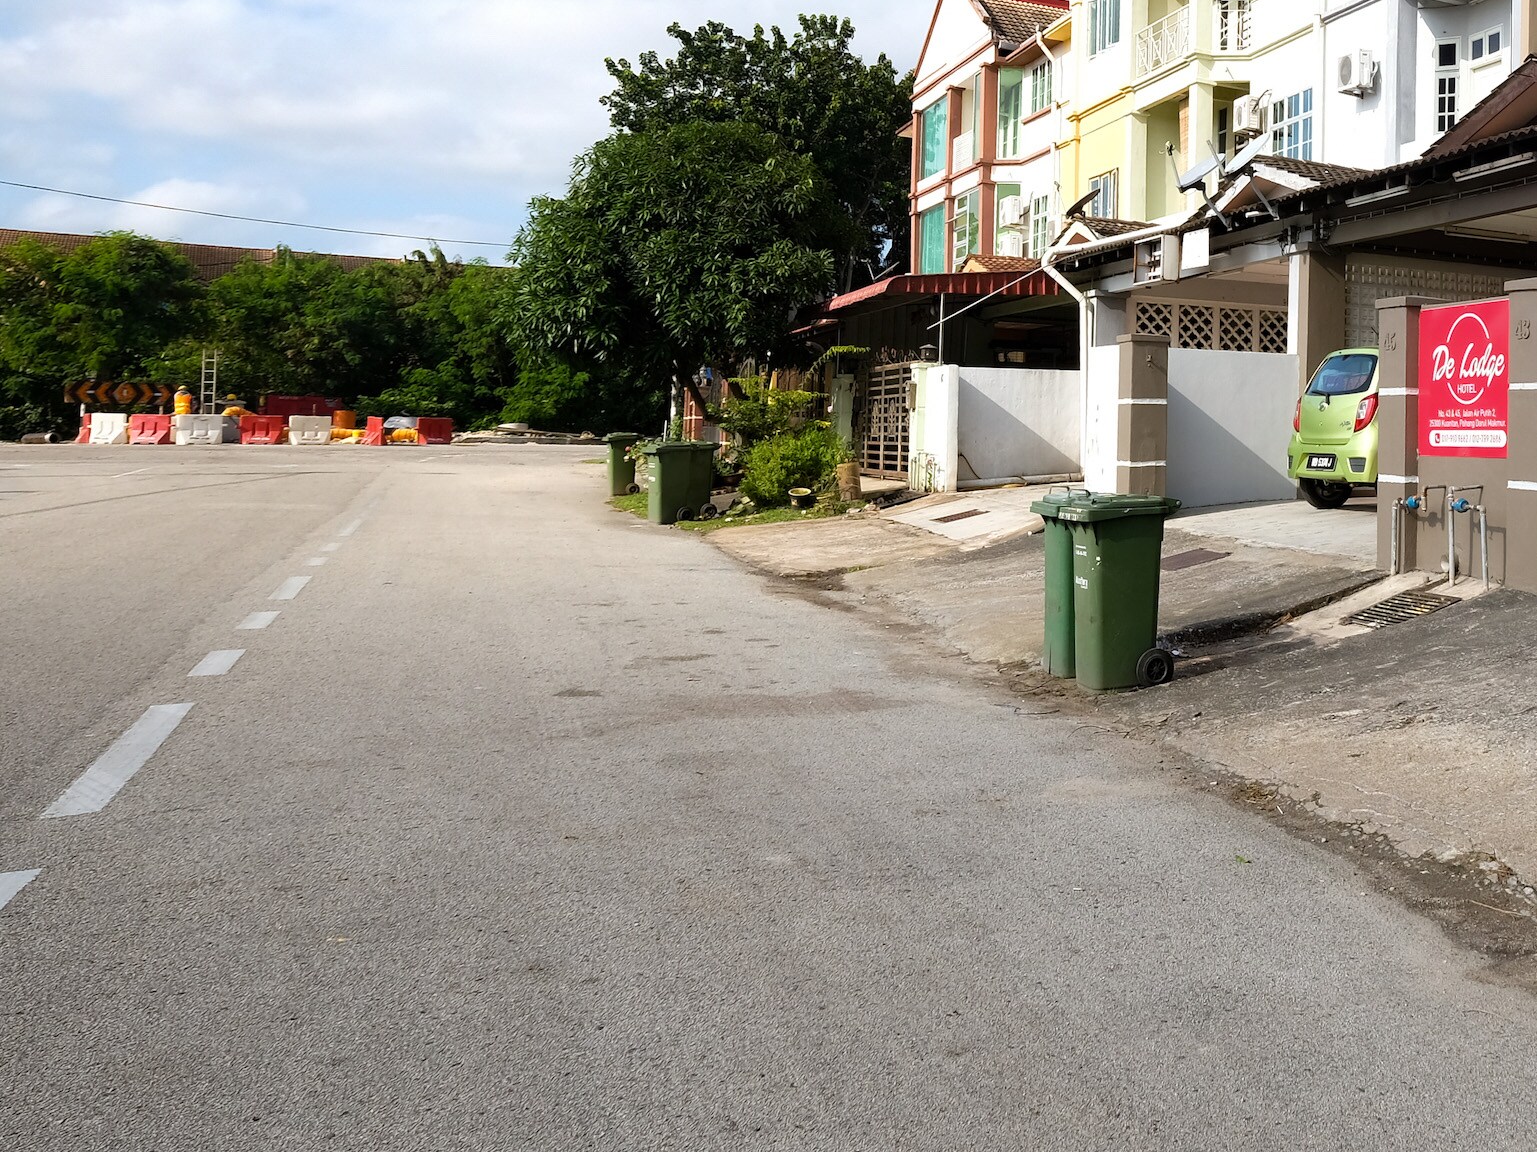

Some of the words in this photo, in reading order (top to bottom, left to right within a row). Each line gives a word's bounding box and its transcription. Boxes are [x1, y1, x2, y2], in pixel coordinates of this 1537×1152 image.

[1515, 319, 1531, 340] 43
[1384, 332, 1397, 351] 45
[1432, 344, 1455, 381] De
[1459, 342, 1505, 387] Lodge
[1457, 383, 1477, 394] HOTEL
